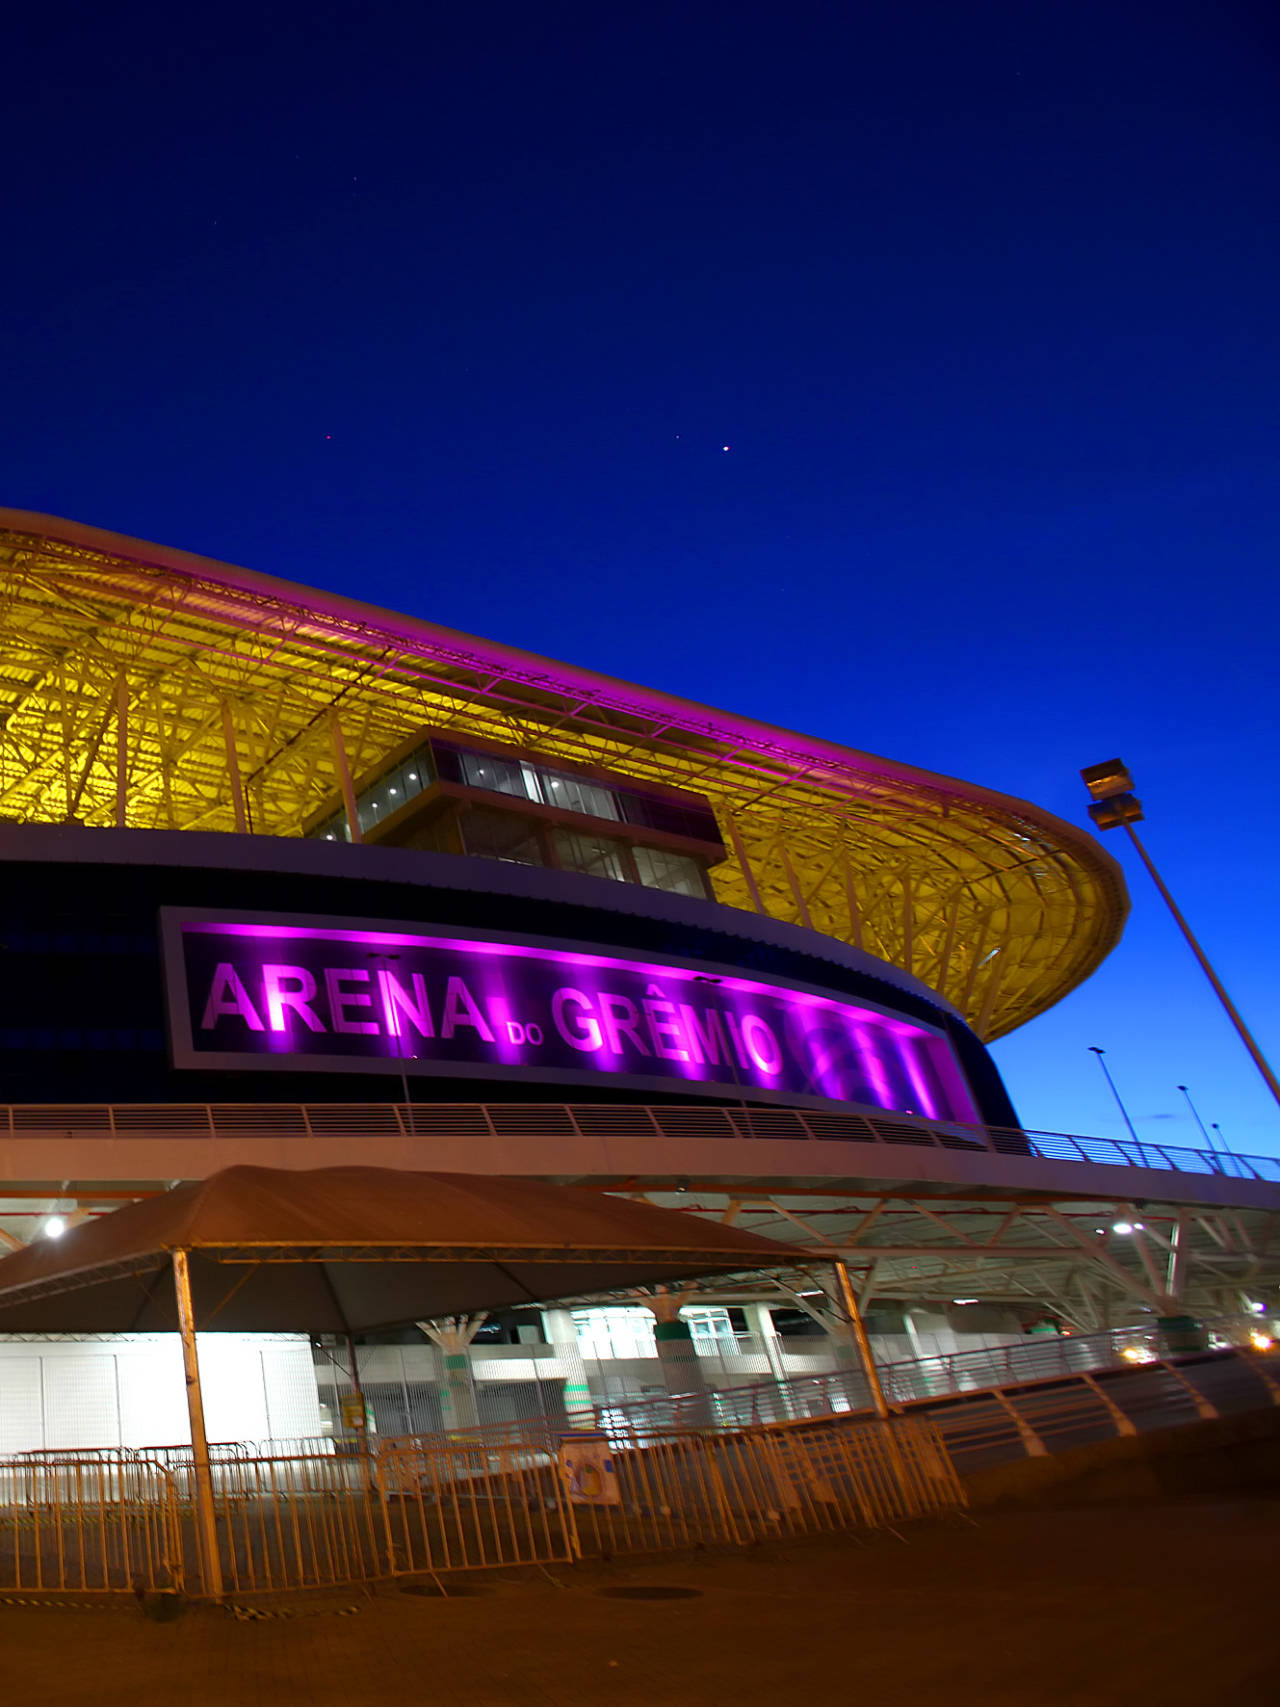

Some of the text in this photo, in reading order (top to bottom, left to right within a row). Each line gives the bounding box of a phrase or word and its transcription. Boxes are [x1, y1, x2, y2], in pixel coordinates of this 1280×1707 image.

[200, 962, 783, 1076] ARENA DO GRÊMIO
